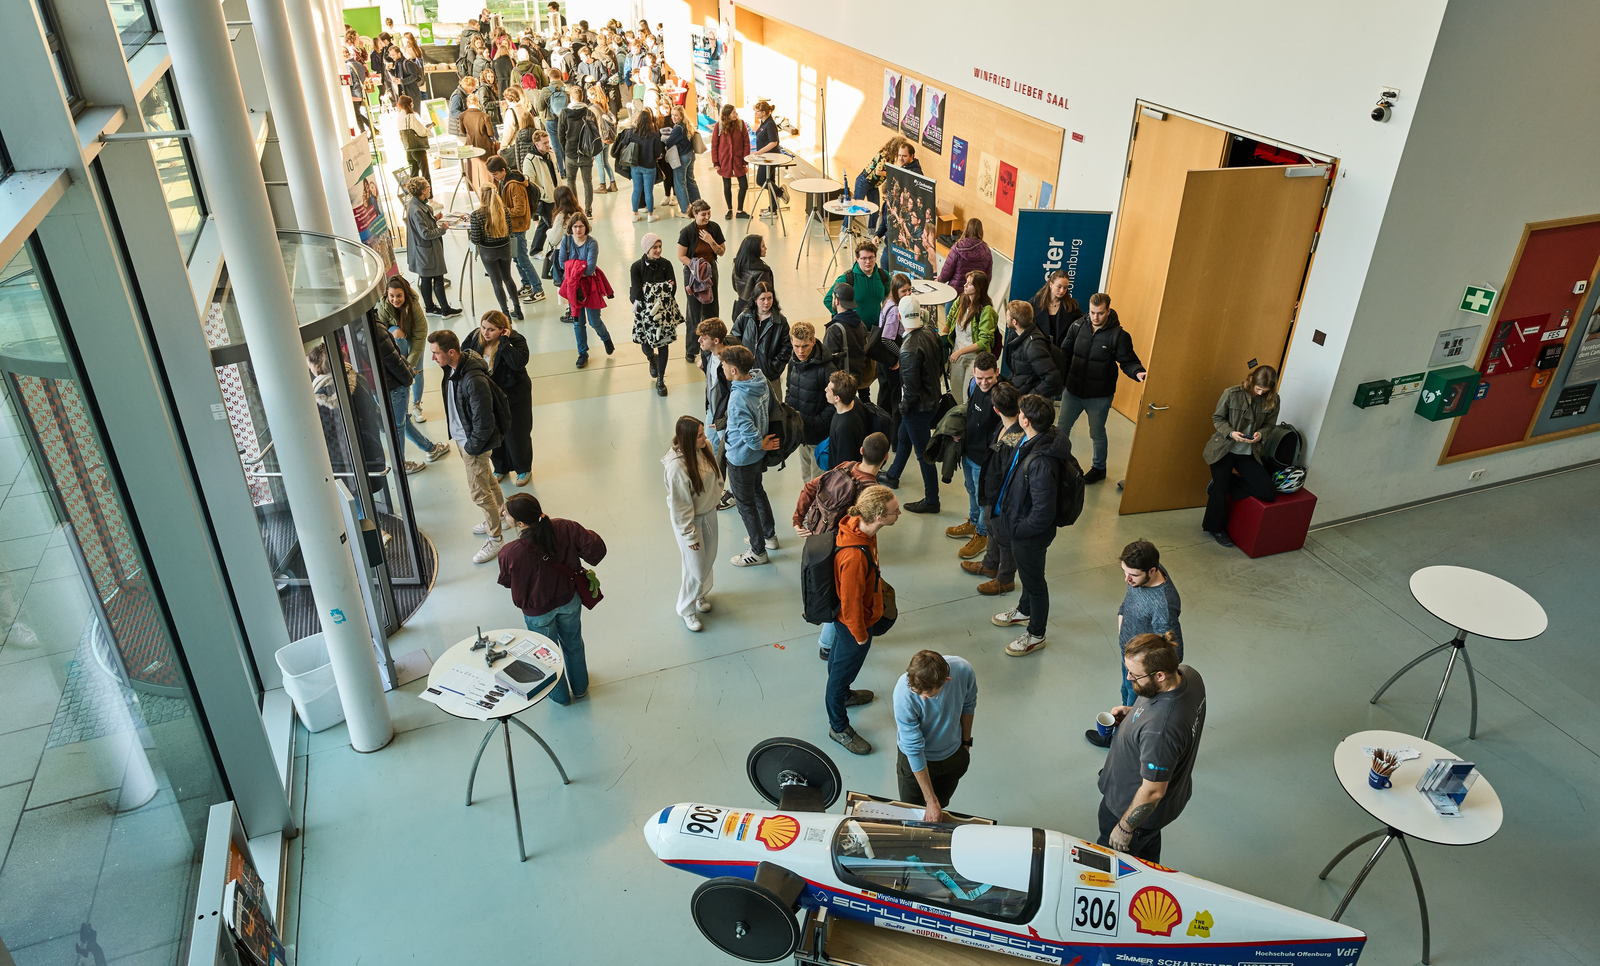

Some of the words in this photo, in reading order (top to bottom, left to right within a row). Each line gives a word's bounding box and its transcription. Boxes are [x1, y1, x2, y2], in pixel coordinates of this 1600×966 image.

[973, 67, 1011, 89] WINFRIED
[1013, 81, 1044, 101] LIEBER
[1046, 92, 1070, 110] SAAL
[897, 255, 925, 273] ORCHESTER
[1547, 331, 1561, 340] FES
[686, 806, 722, 834] 306
[877, 893, 899, 904] Virginia
[900, 898, 913, 907] Wolf
[1075, 896, 1117, 931] 306
[832, 896, 1064, 954] SCHLUCKSPECHT
[916, 929, 945, 940] DUPONT
[960, 939, 991, 949] SCHMID
[1007, 951, 1032, 959] ALTAIR
[1336, 948, 1359, 957] VdF
